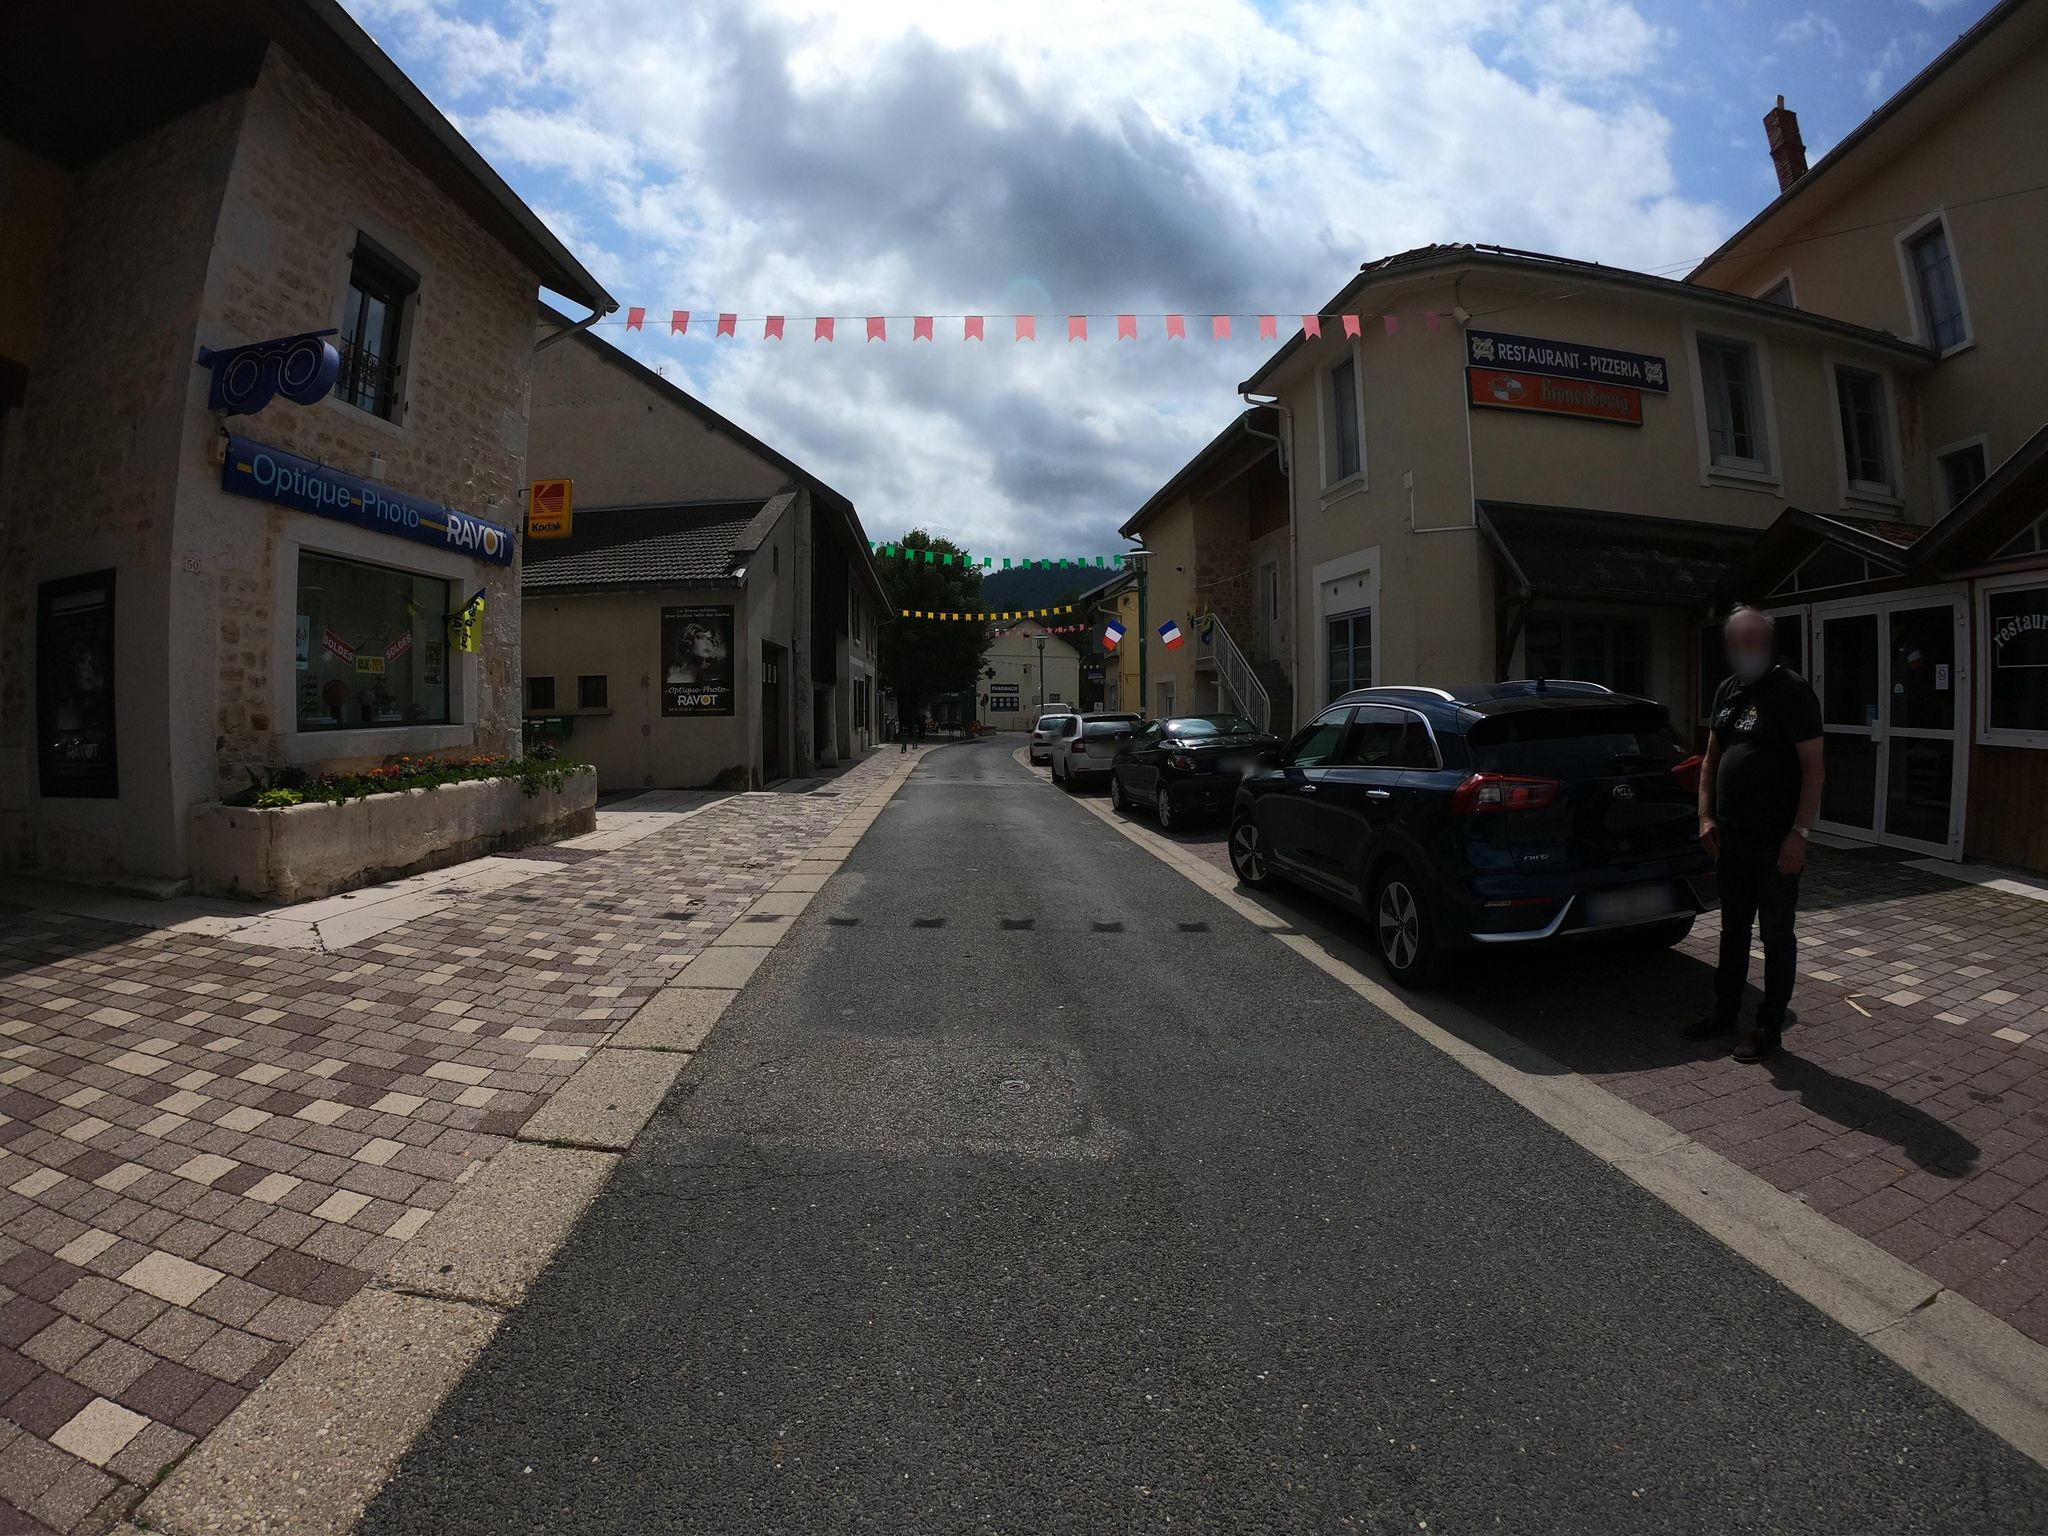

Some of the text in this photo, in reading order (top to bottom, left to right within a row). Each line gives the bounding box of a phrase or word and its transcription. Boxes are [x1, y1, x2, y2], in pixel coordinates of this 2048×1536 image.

[1497, 342, 1579, 369] RESTAURANT
[1590, 355, 1642, 379] PIZZERIA
[1542, 377, 1629, 416] Kronenbourg
[252, 453, 507, 558] Optique Photo RAVOT
[532, 522, 561, 531] Kodak
[186, 559, 199, 570] 50
[322, 635, 354, 662] SOLDES
[385, 634, 412, 660] SOLDES
[677, 694, 719, 706] RAVOT
